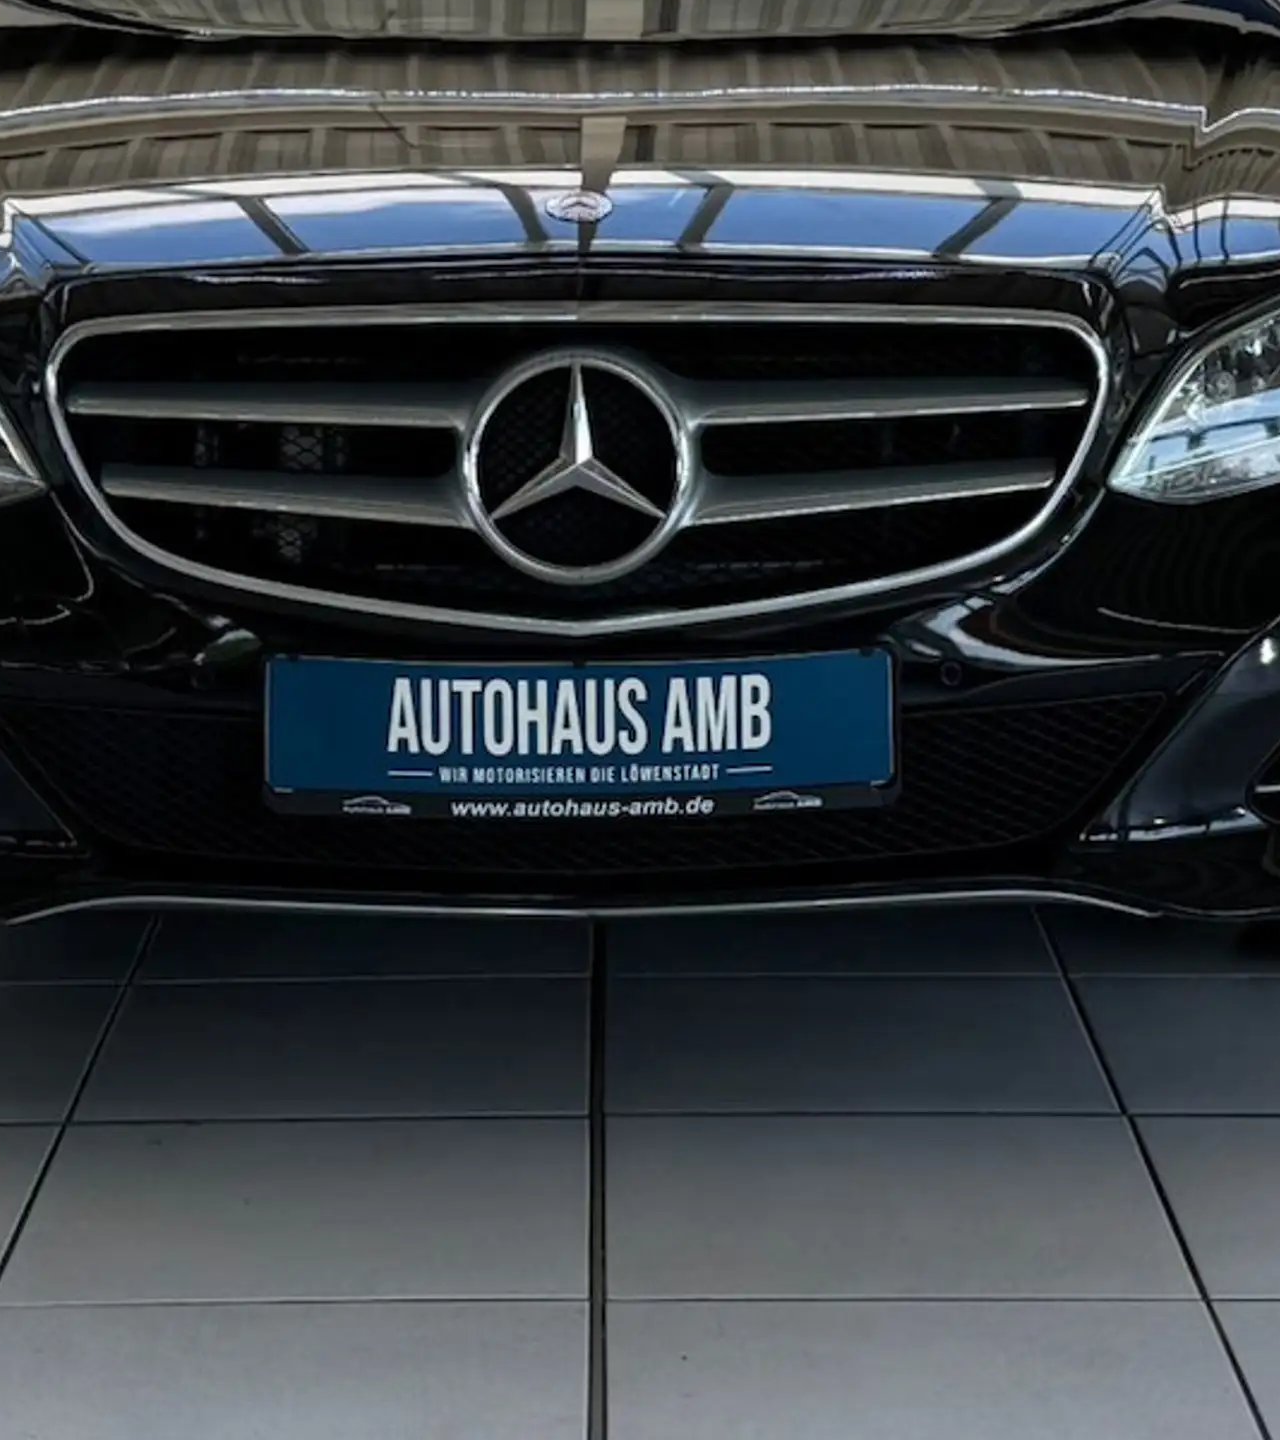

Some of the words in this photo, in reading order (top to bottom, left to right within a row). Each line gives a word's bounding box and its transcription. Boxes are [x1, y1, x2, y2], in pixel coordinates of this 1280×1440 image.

[386, 677, 649, 757] AUTOHAUS
[660, 672, 774, 754] AMB
[438, 766, 469, 784] WIR
[472, 766, 587, 785] MOTORISIEREN
[590, 766, 616, 785] DIE
[620, 763, 721, 784] LÖWENSTADT
[450, 794, 716, 818] www.autohaus-amb.de
